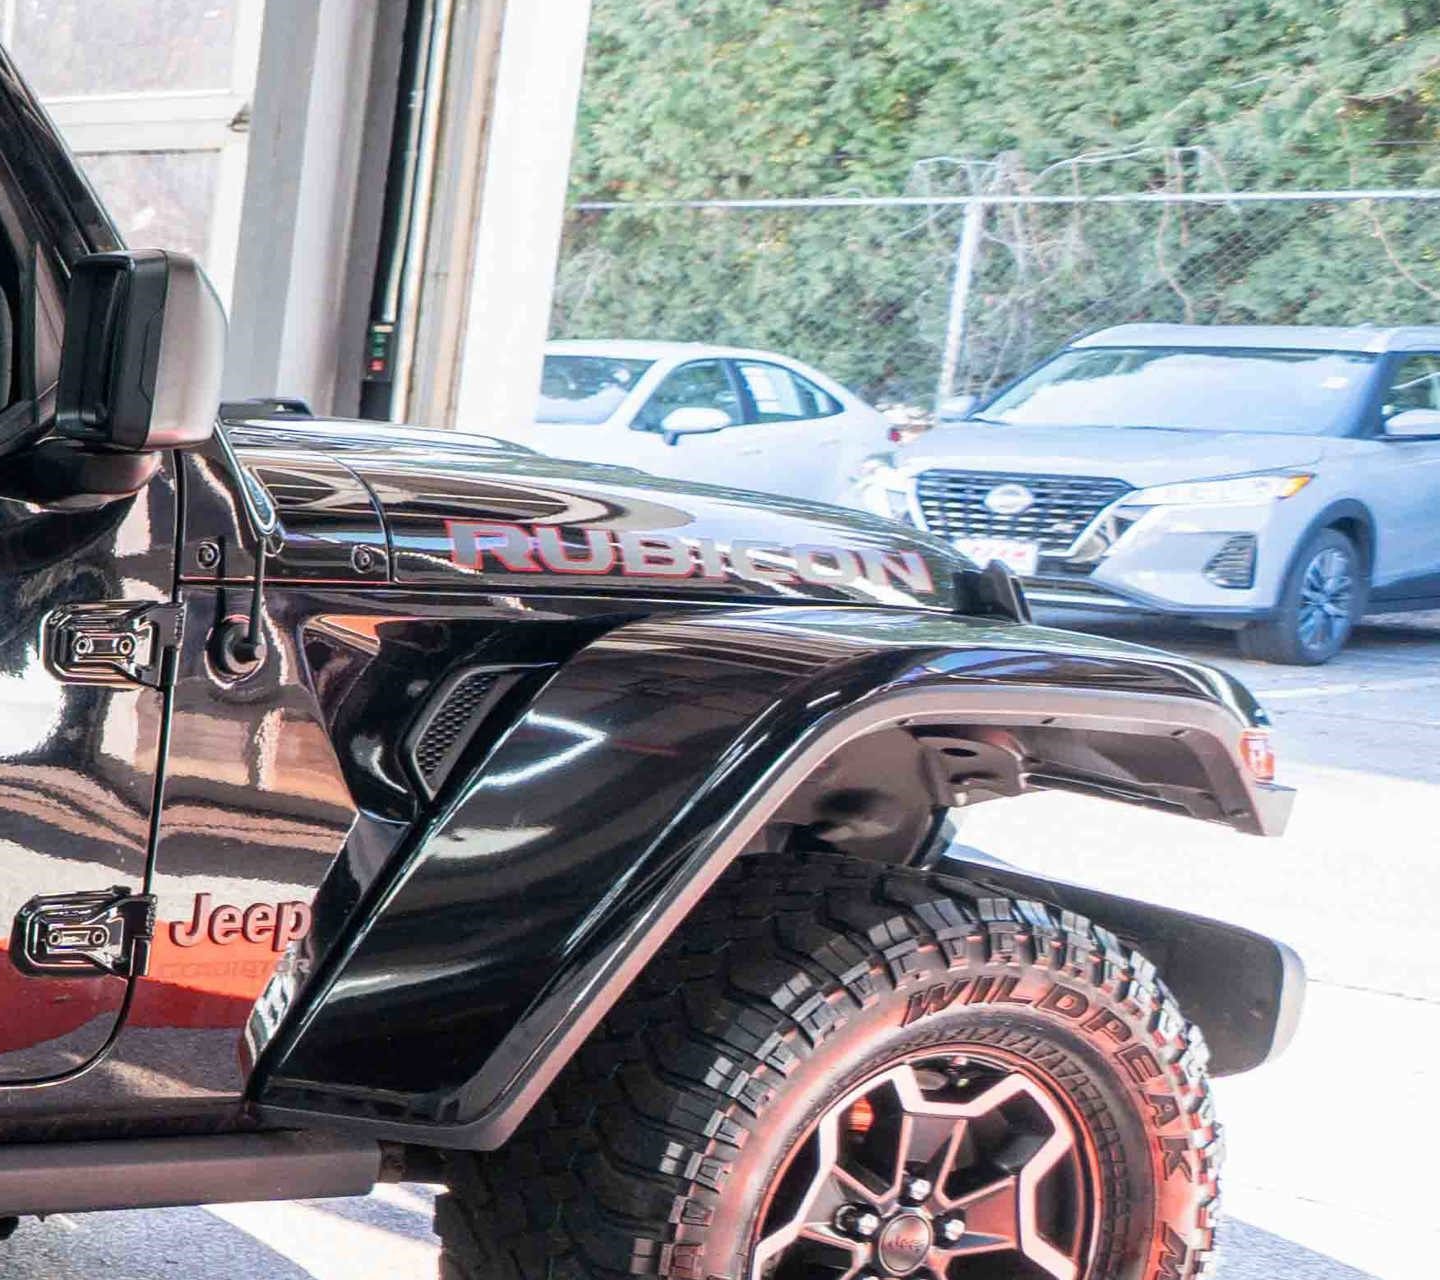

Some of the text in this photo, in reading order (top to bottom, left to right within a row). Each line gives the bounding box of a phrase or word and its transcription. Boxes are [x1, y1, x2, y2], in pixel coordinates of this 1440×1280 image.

[443, 519, 934, 594] RUBICON
[169, 892, 312, 952] Jeep
[902, 974, 1193, 1184] WILDPEAK
